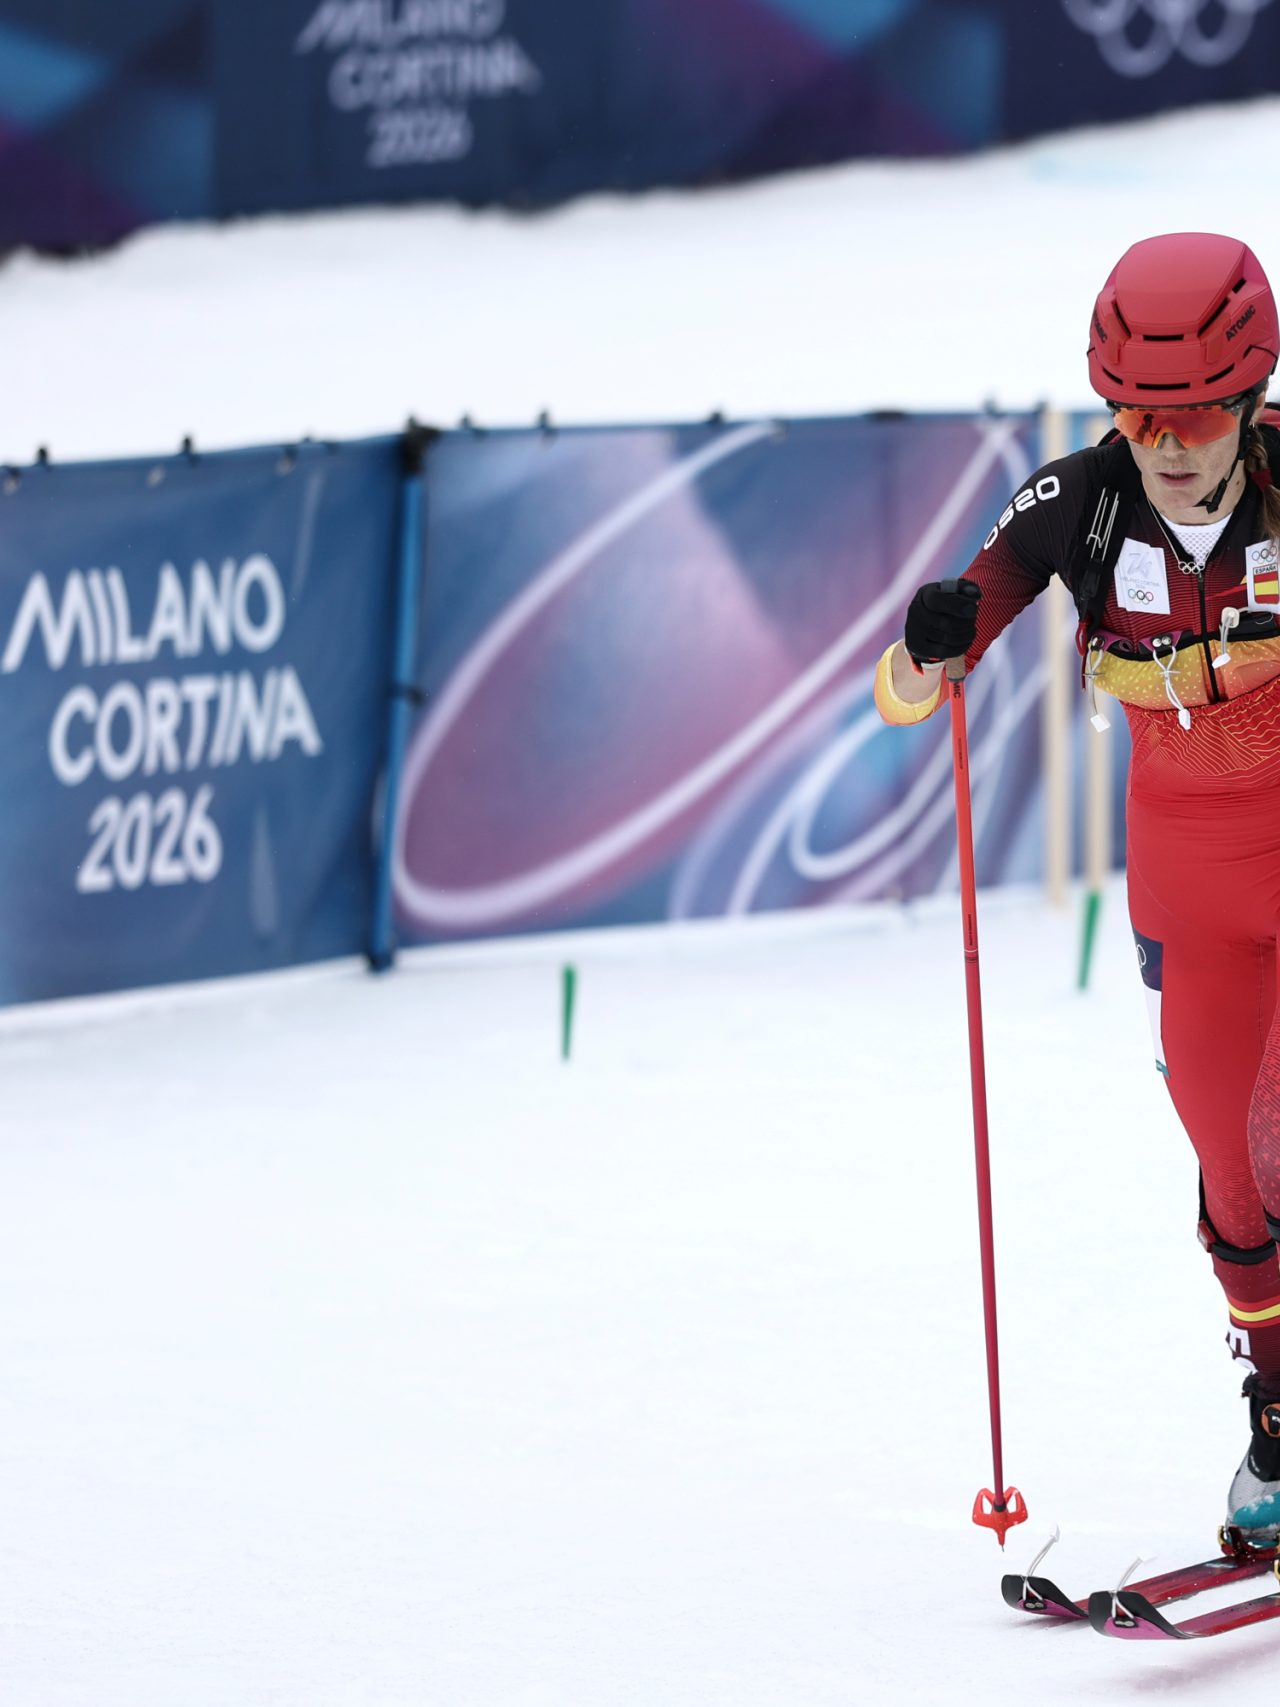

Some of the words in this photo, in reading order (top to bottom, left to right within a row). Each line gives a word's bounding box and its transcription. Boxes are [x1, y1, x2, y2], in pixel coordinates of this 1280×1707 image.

[1226, 304, 1256, 342] ATOMIC
[4, 553, 286, 672] MILANO
[49, 666, 322, 785] CORTINA
[77, 785, 222, 892] 2026
